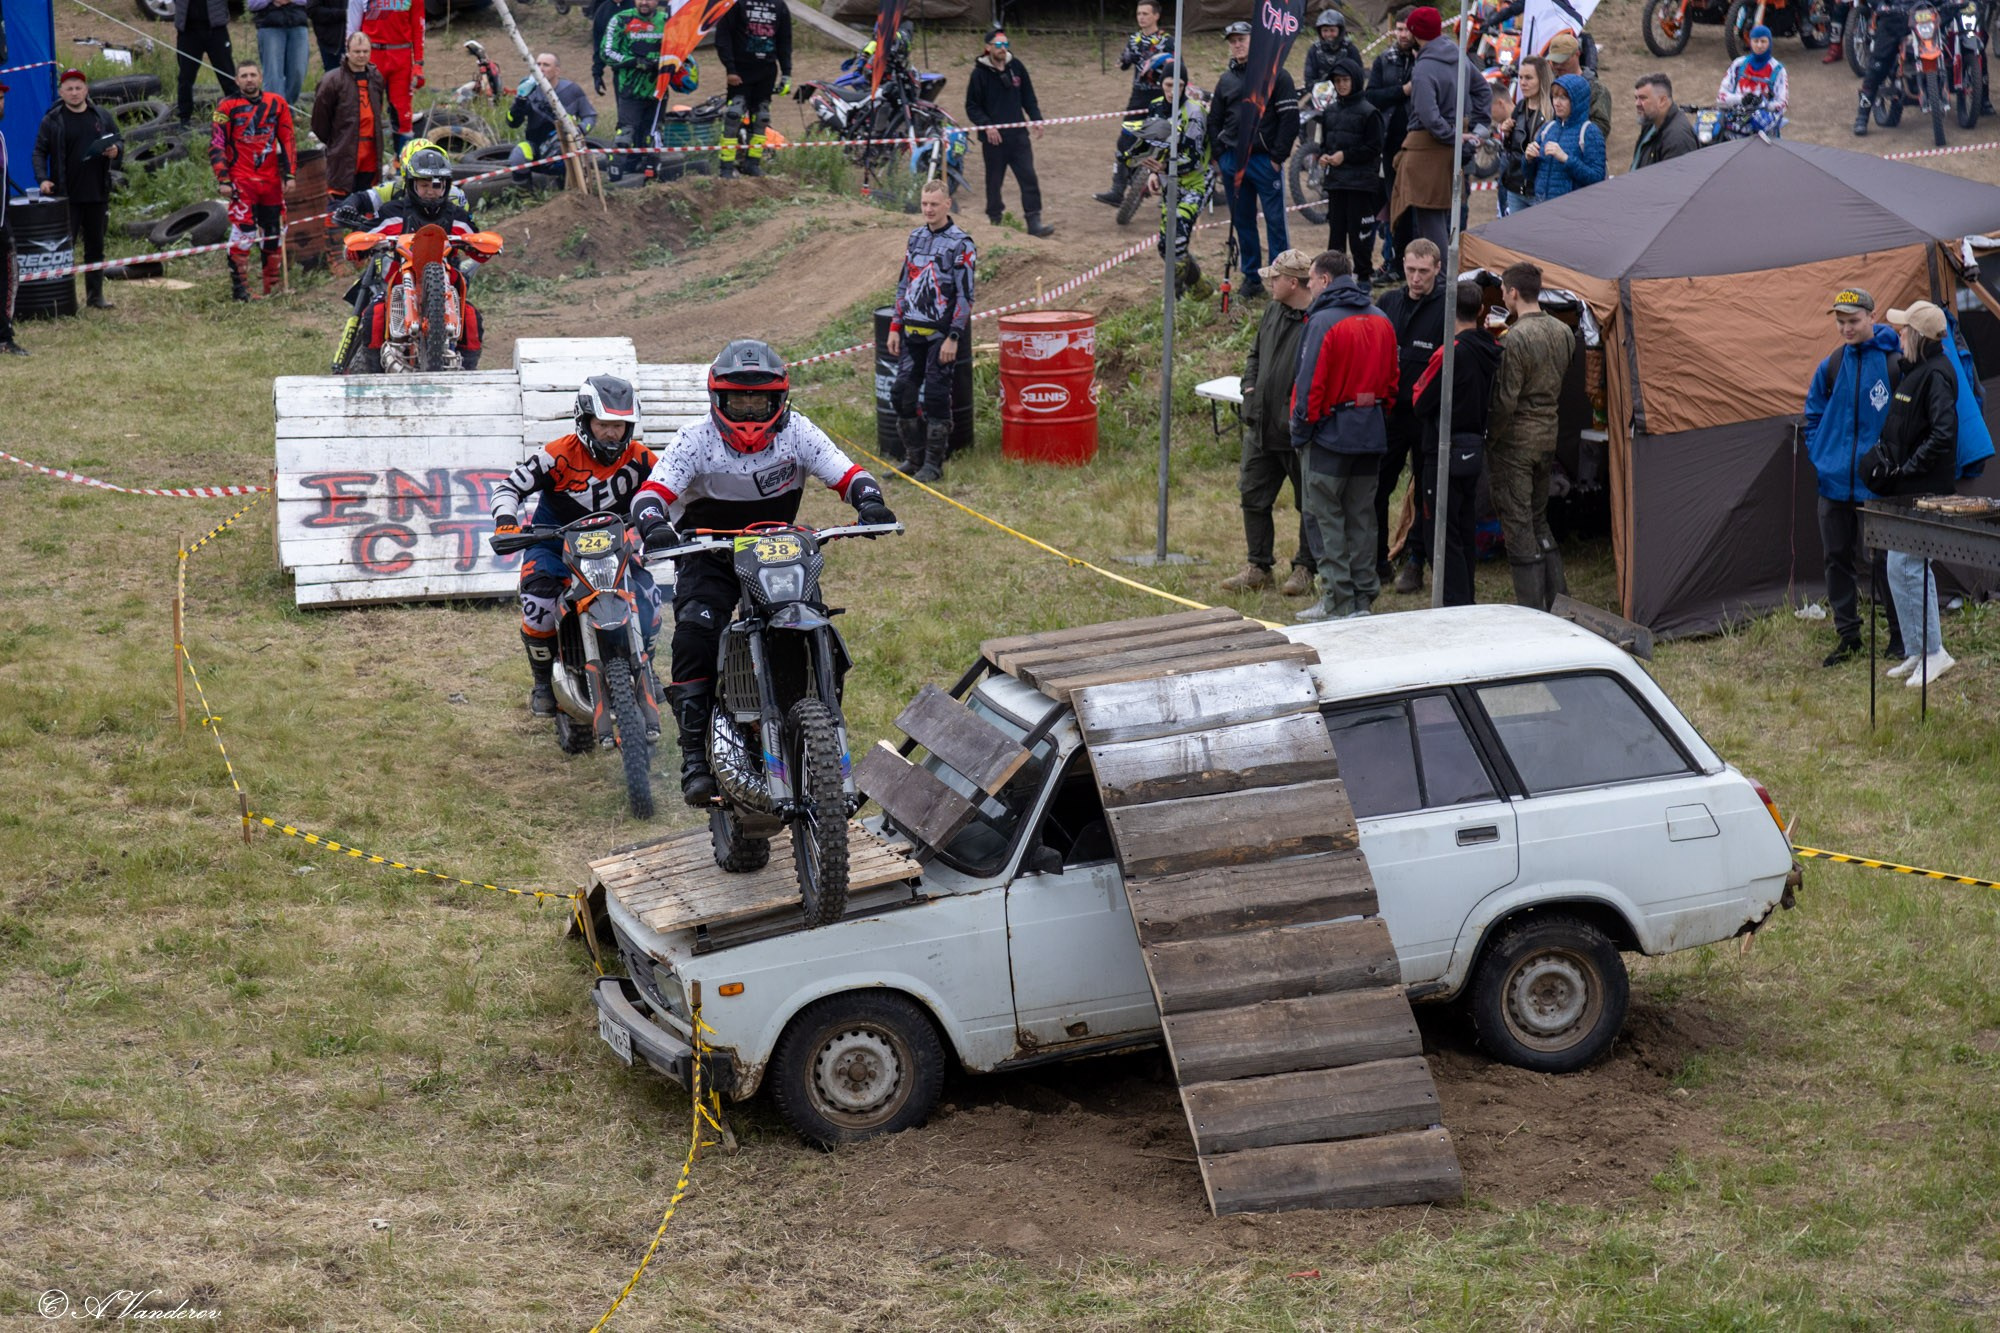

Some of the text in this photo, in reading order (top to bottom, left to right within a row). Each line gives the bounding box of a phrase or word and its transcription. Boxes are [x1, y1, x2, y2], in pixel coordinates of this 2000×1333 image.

[1022, 392, 1067, 403] SINTEC
[585, 539, 602, 548] 24
[768, 544, 789, 555] 38
